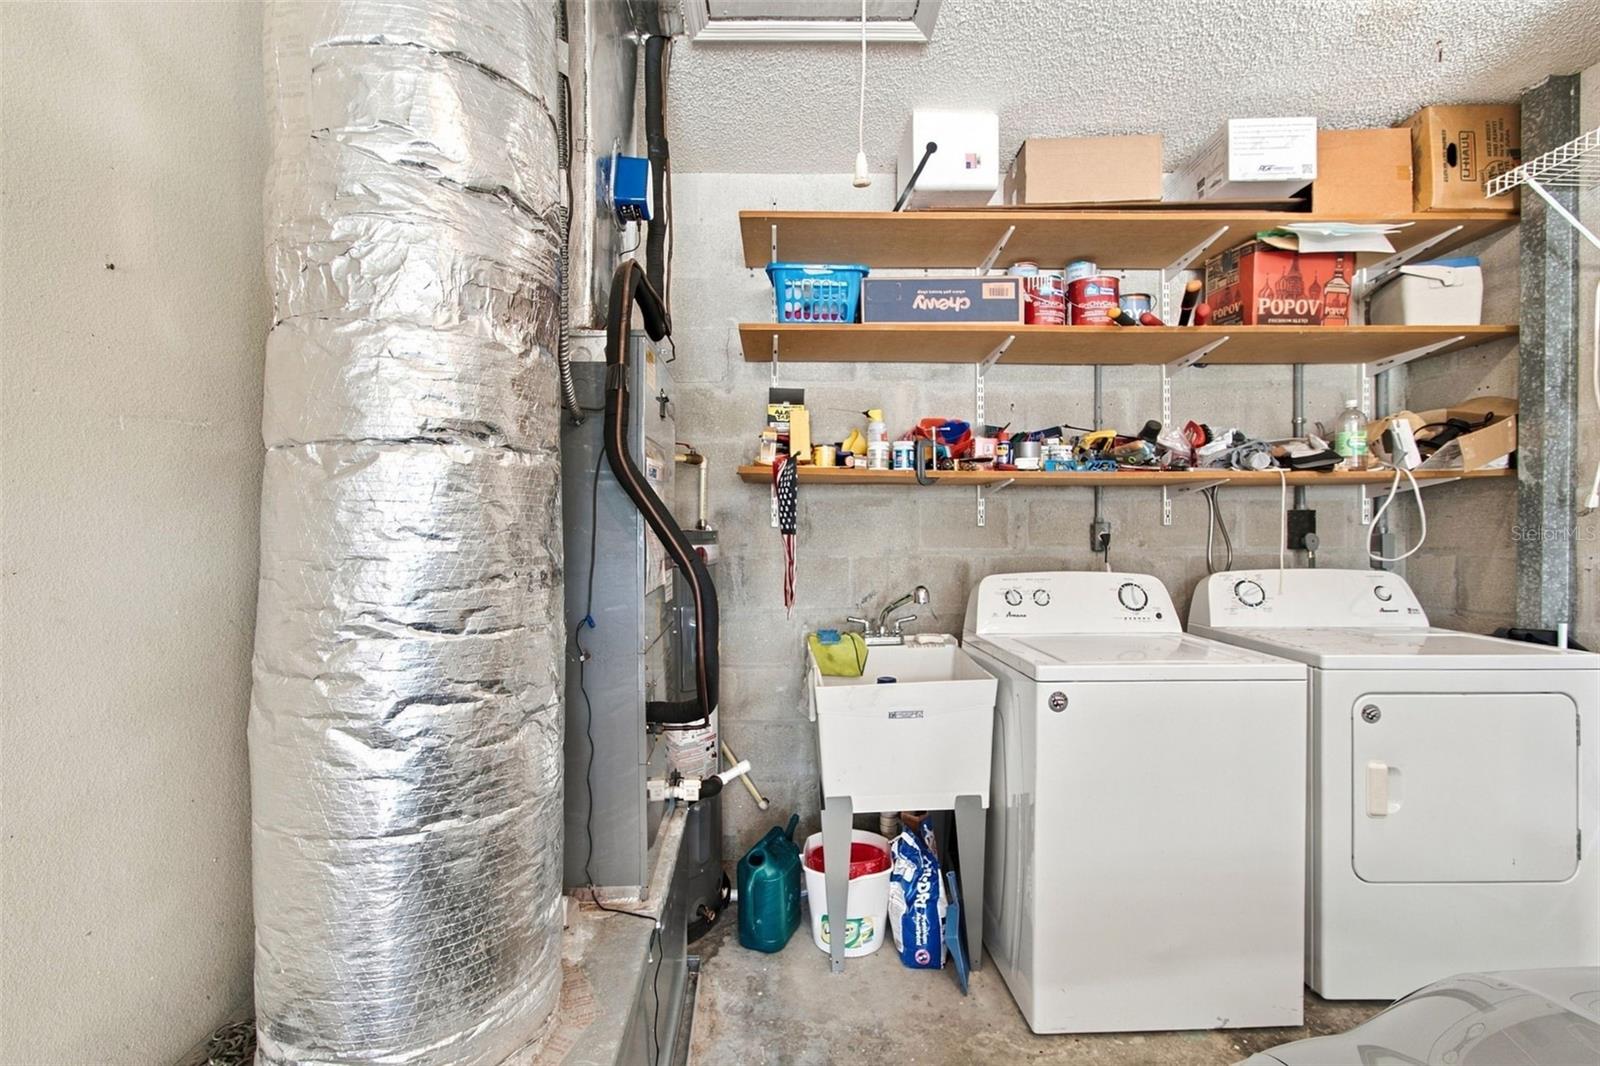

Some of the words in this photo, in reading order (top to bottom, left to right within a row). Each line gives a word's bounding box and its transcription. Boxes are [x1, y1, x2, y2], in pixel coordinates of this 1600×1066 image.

[1461, 133, 1470, 178] U-HAUL
[912, 294, 971, 312] chewy
[1213, 301, 1242, 319] POPOV
[1257, 298, 1321, 316] POPOV
